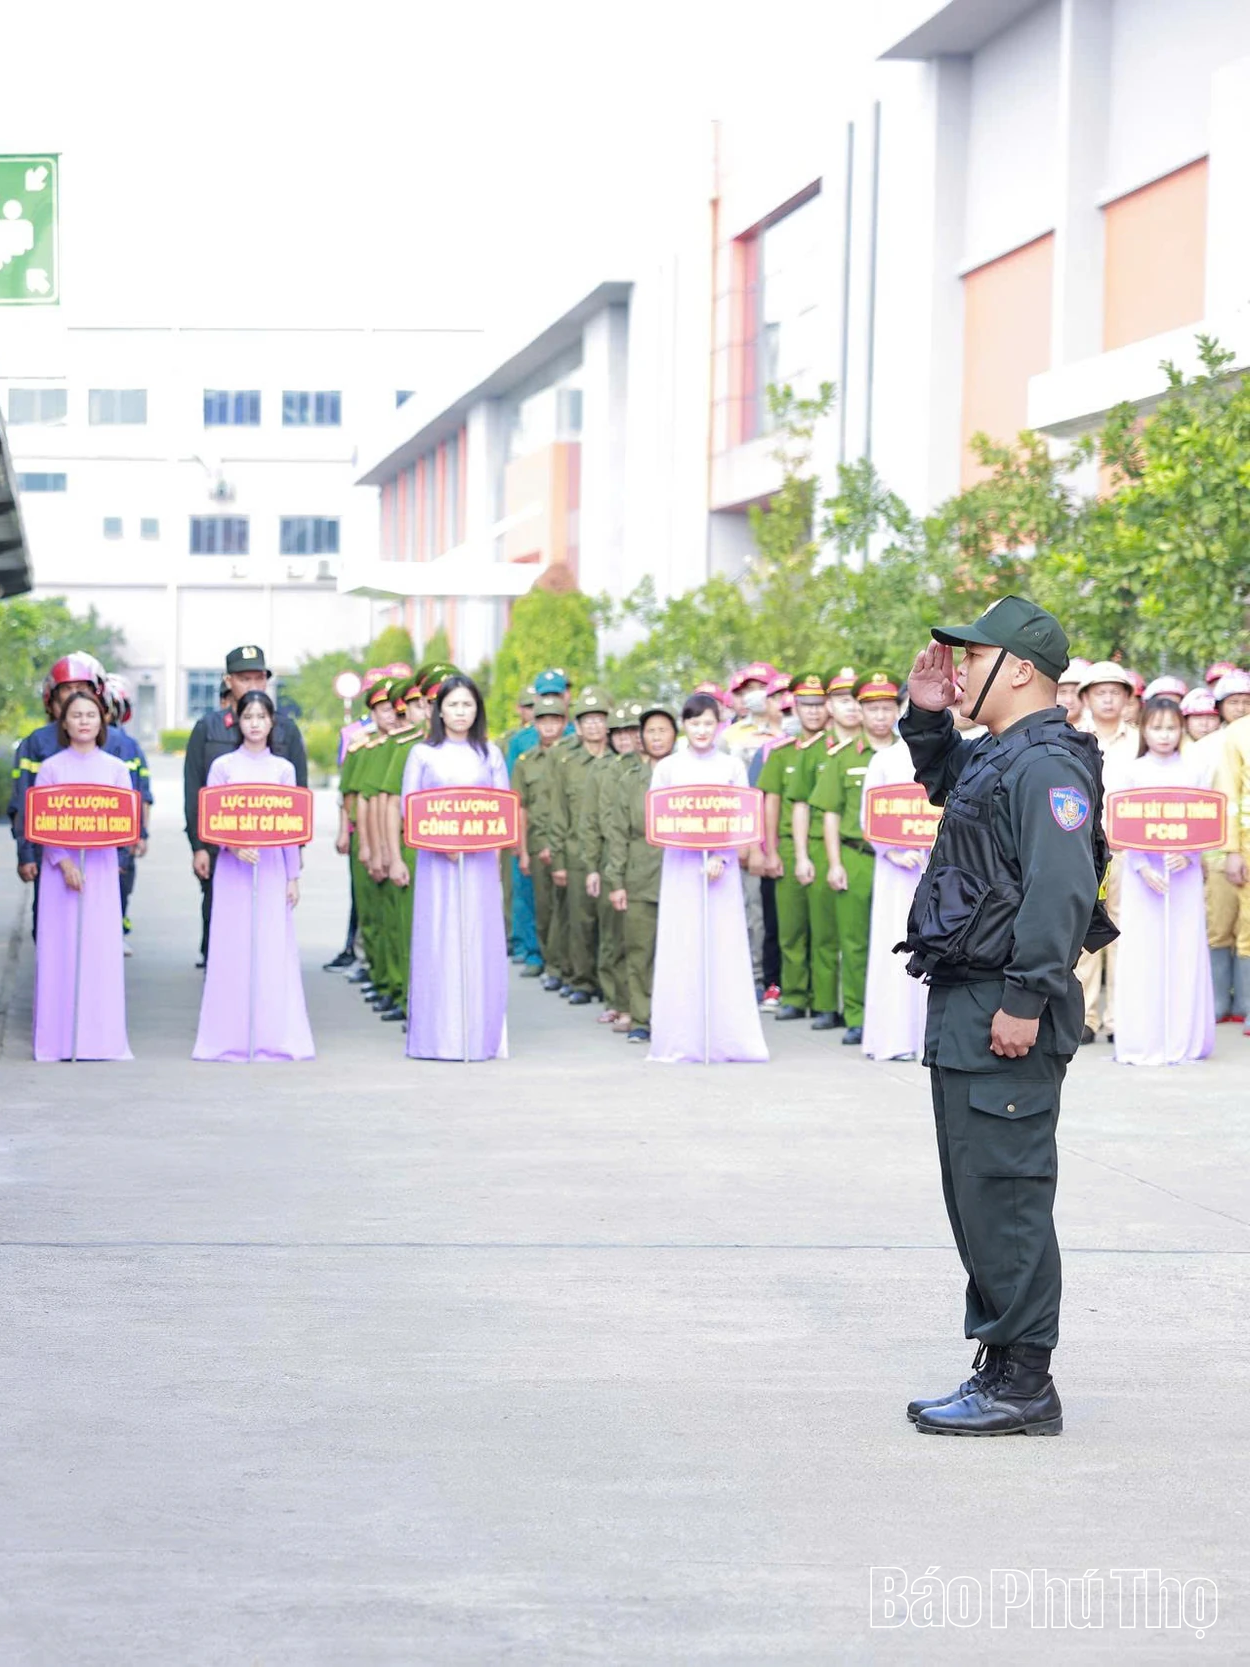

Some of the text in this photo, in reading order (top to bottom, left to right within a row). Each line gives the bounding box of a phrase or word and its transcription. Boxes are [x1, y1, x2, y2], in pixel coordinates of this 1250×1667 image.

[48, 794, 119, 812] LỰC LƯỢNG
[221, 794, 293, 811] LỰC LƯỢNG
[427, 798, 499, 815] LỰC LƯỢNG
[668, 795, 741, 812] LỰC LƯỢNG
[58, 813, 73, 831] SÁT
[210, 811, 237, 831] CẢNH
[239, 813, 259, 831] SÁT
[418, 816, 507, 835] CÔNG AN XÃ
